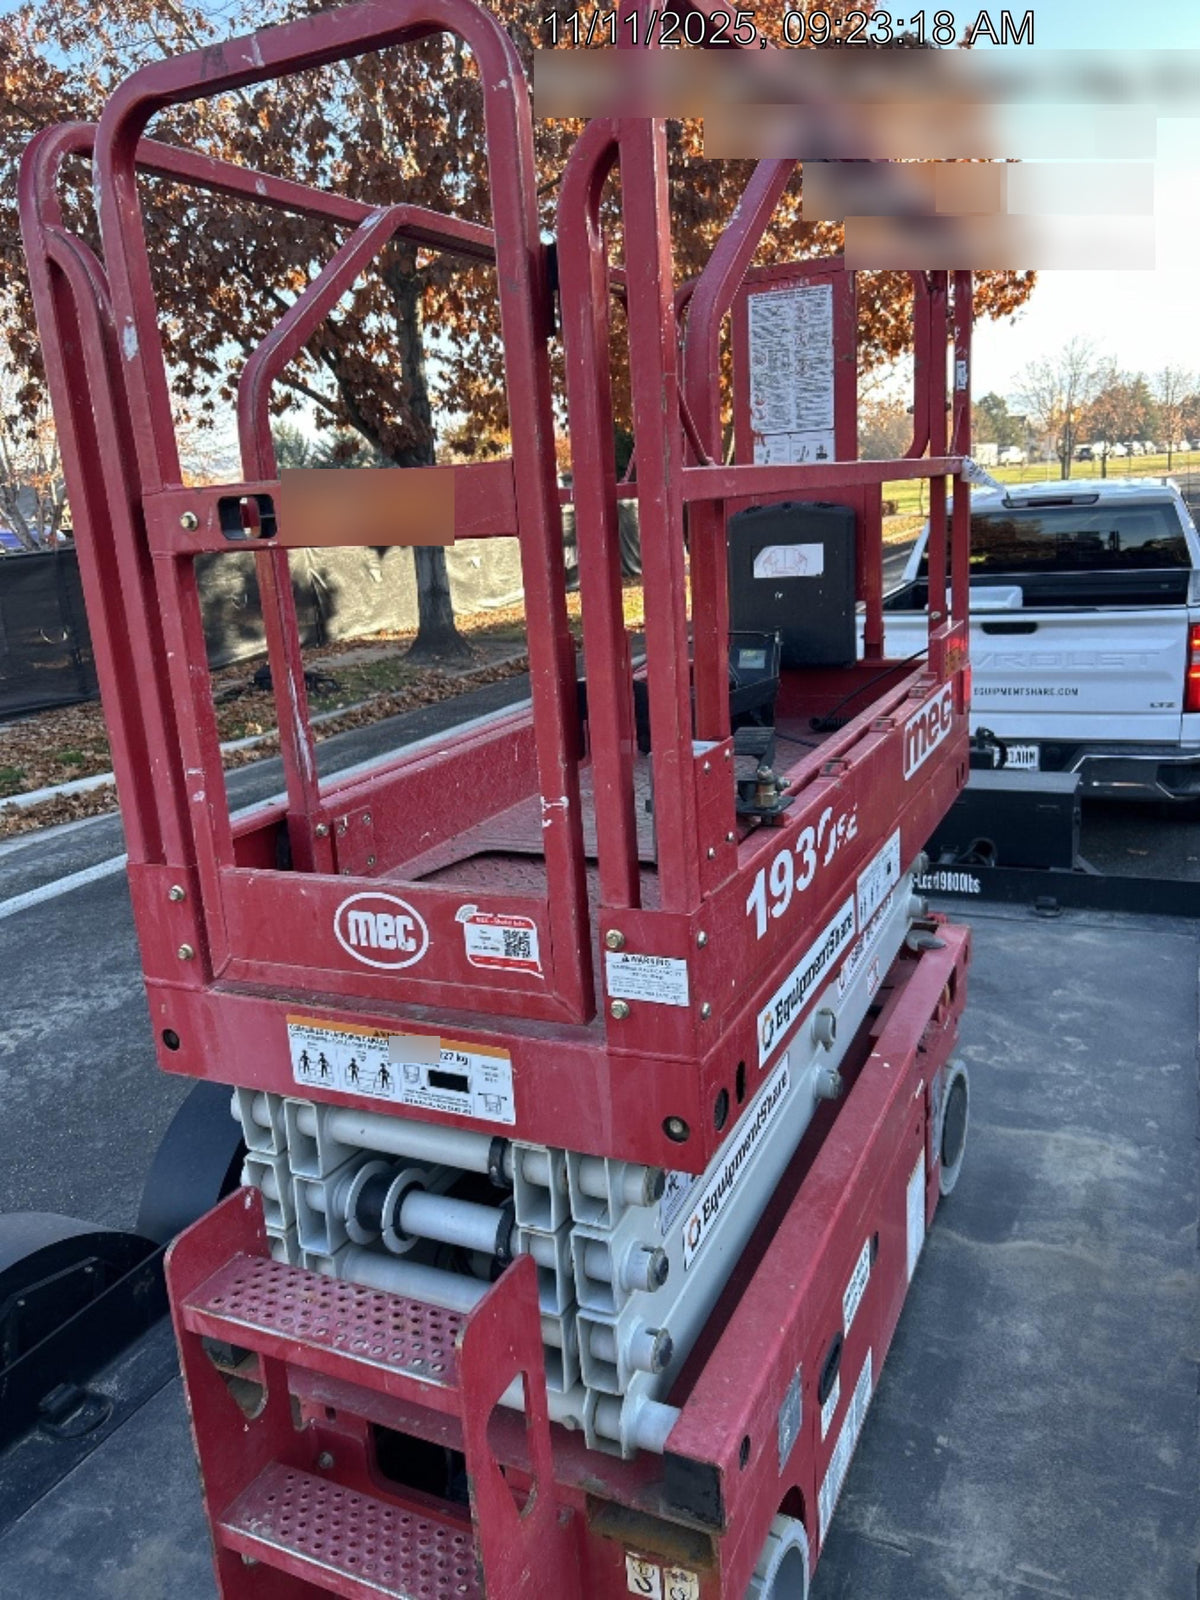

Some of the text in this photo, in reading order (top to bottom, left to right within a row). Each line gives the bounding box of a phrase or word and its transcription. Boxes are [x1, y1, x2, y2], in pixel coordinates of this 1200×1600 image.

[774, 910, 853, 1029] EquipmentShare
[456, 1053, 469, 1066] kg
[701, 1070, 788, 1220] EquipmentShare
